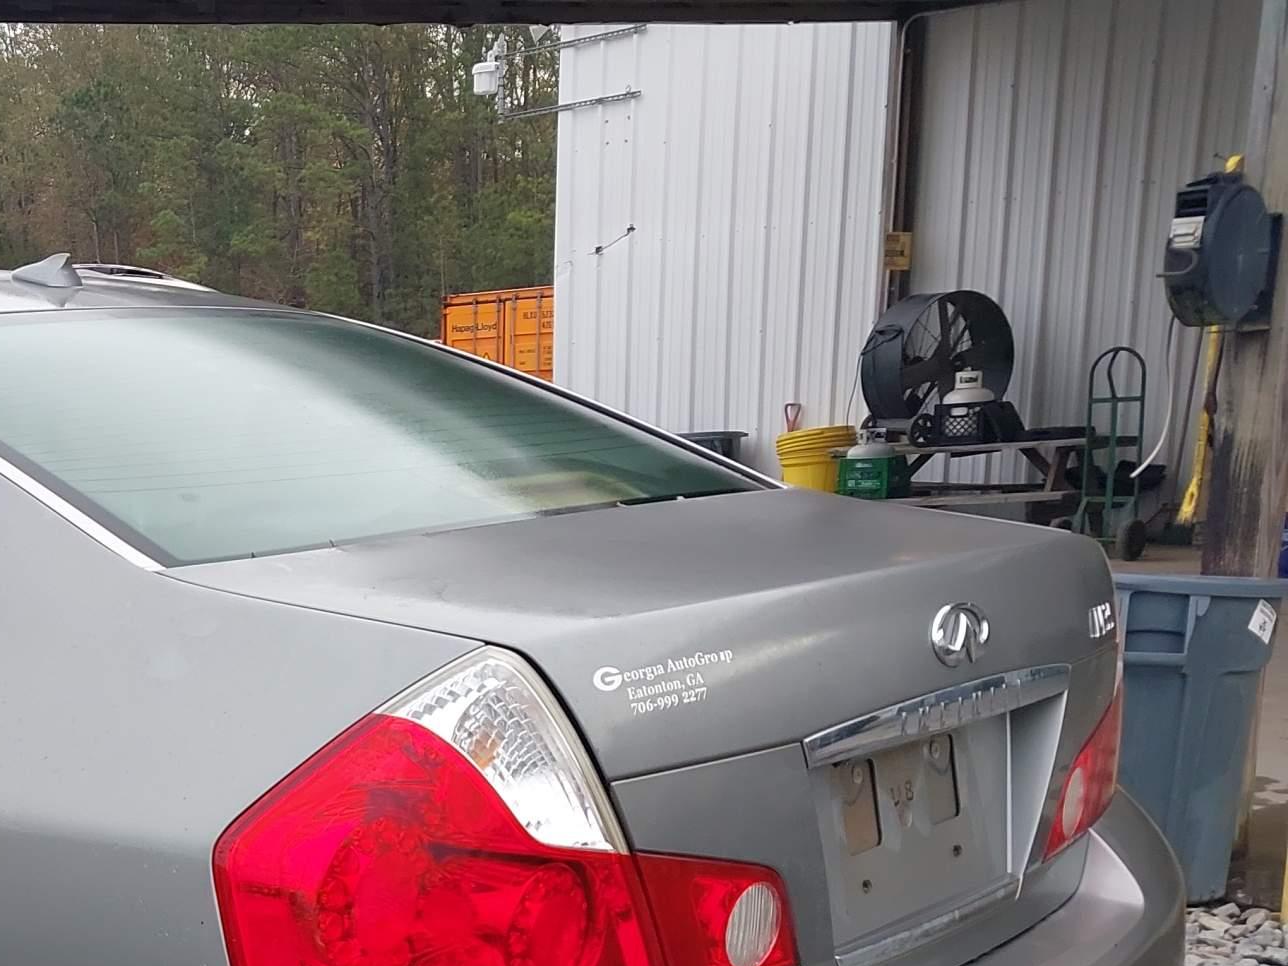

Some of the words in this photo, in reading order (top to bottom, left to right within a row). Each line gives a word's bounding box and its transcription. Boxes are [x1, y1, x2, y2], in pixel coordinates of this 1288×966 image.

[452, 322, 497, 334] HapagLloyd
[593, 663, 665, 692] Georgia
[627, 679, 685, 700] Eatonton,
[686, 671, 704, 687] GA
[631, 693, 679, 716] 706-999
[682, 687, 707, 703] 2277
